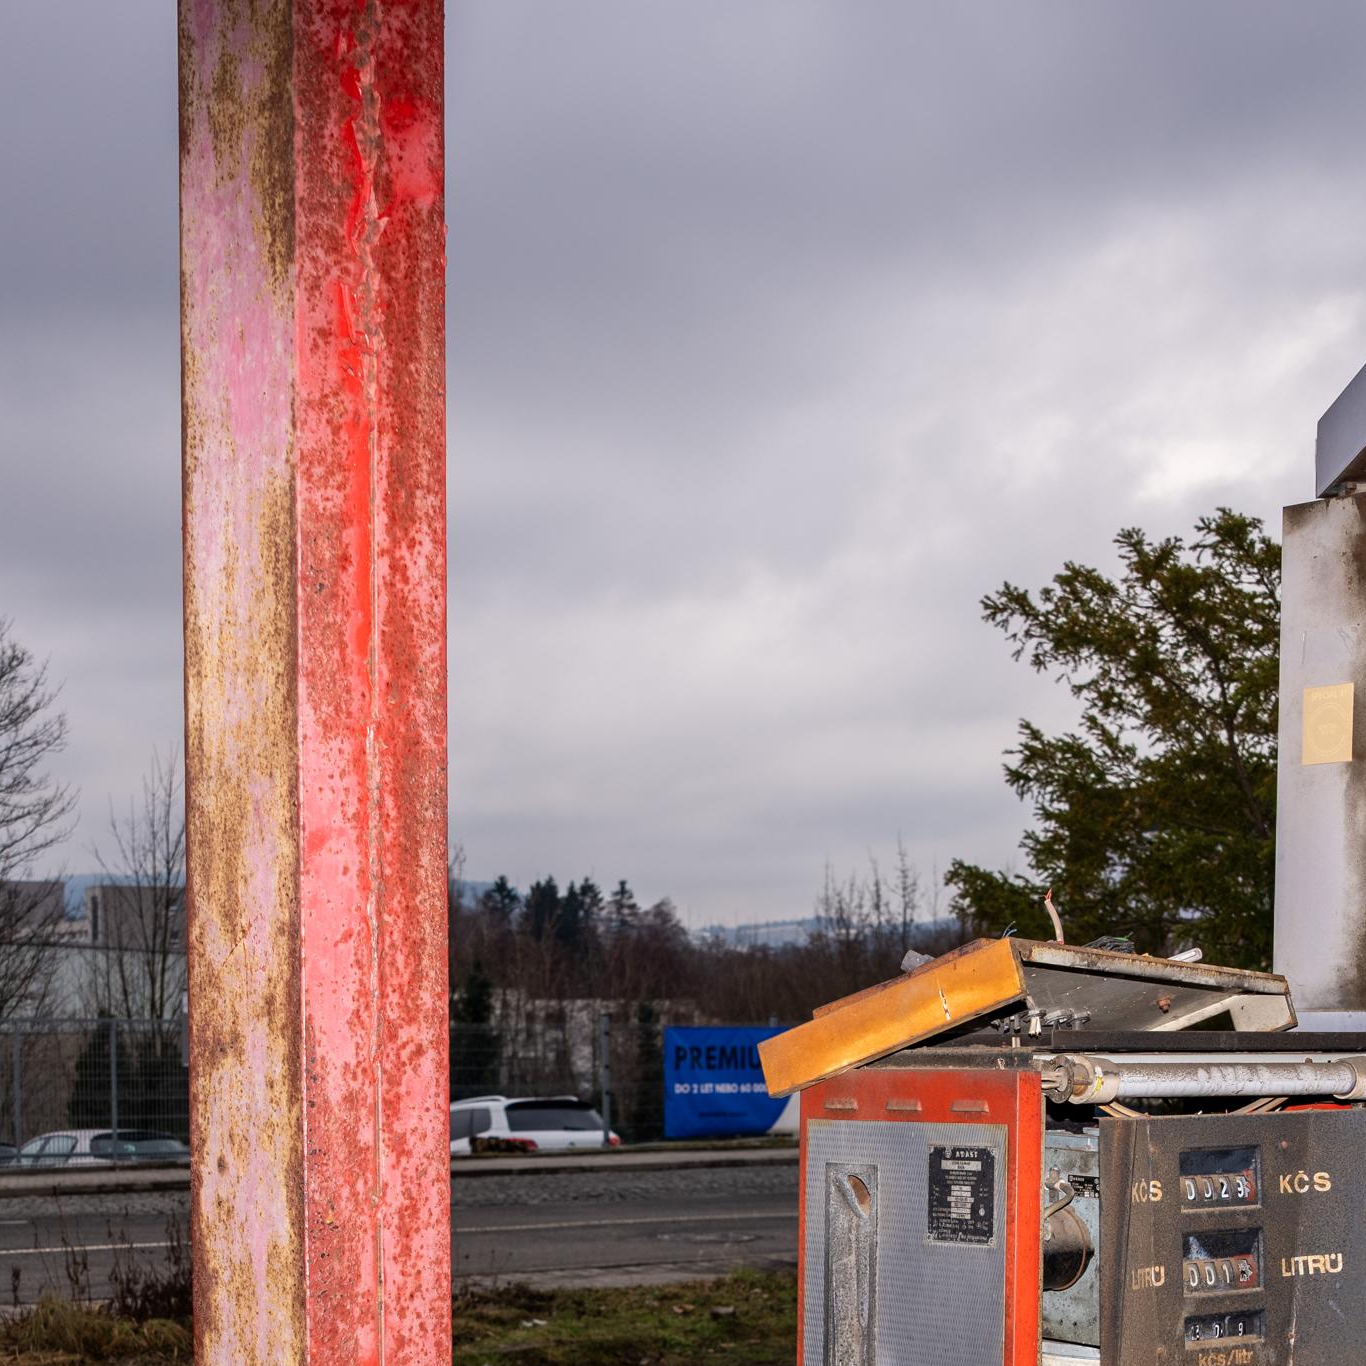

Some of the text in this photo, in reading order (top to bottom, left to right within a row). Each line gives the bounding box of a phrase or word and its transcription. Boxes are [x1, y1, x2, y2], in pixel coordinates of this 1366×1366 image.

[1131, 1179, 1163, 1203] KČS
[1279, 1170, 1332, 1194] KČS
[1281, 1253, 1343, 1277] LITRŮ
[1131, 1265, 1165, 1290] LITRŮ
